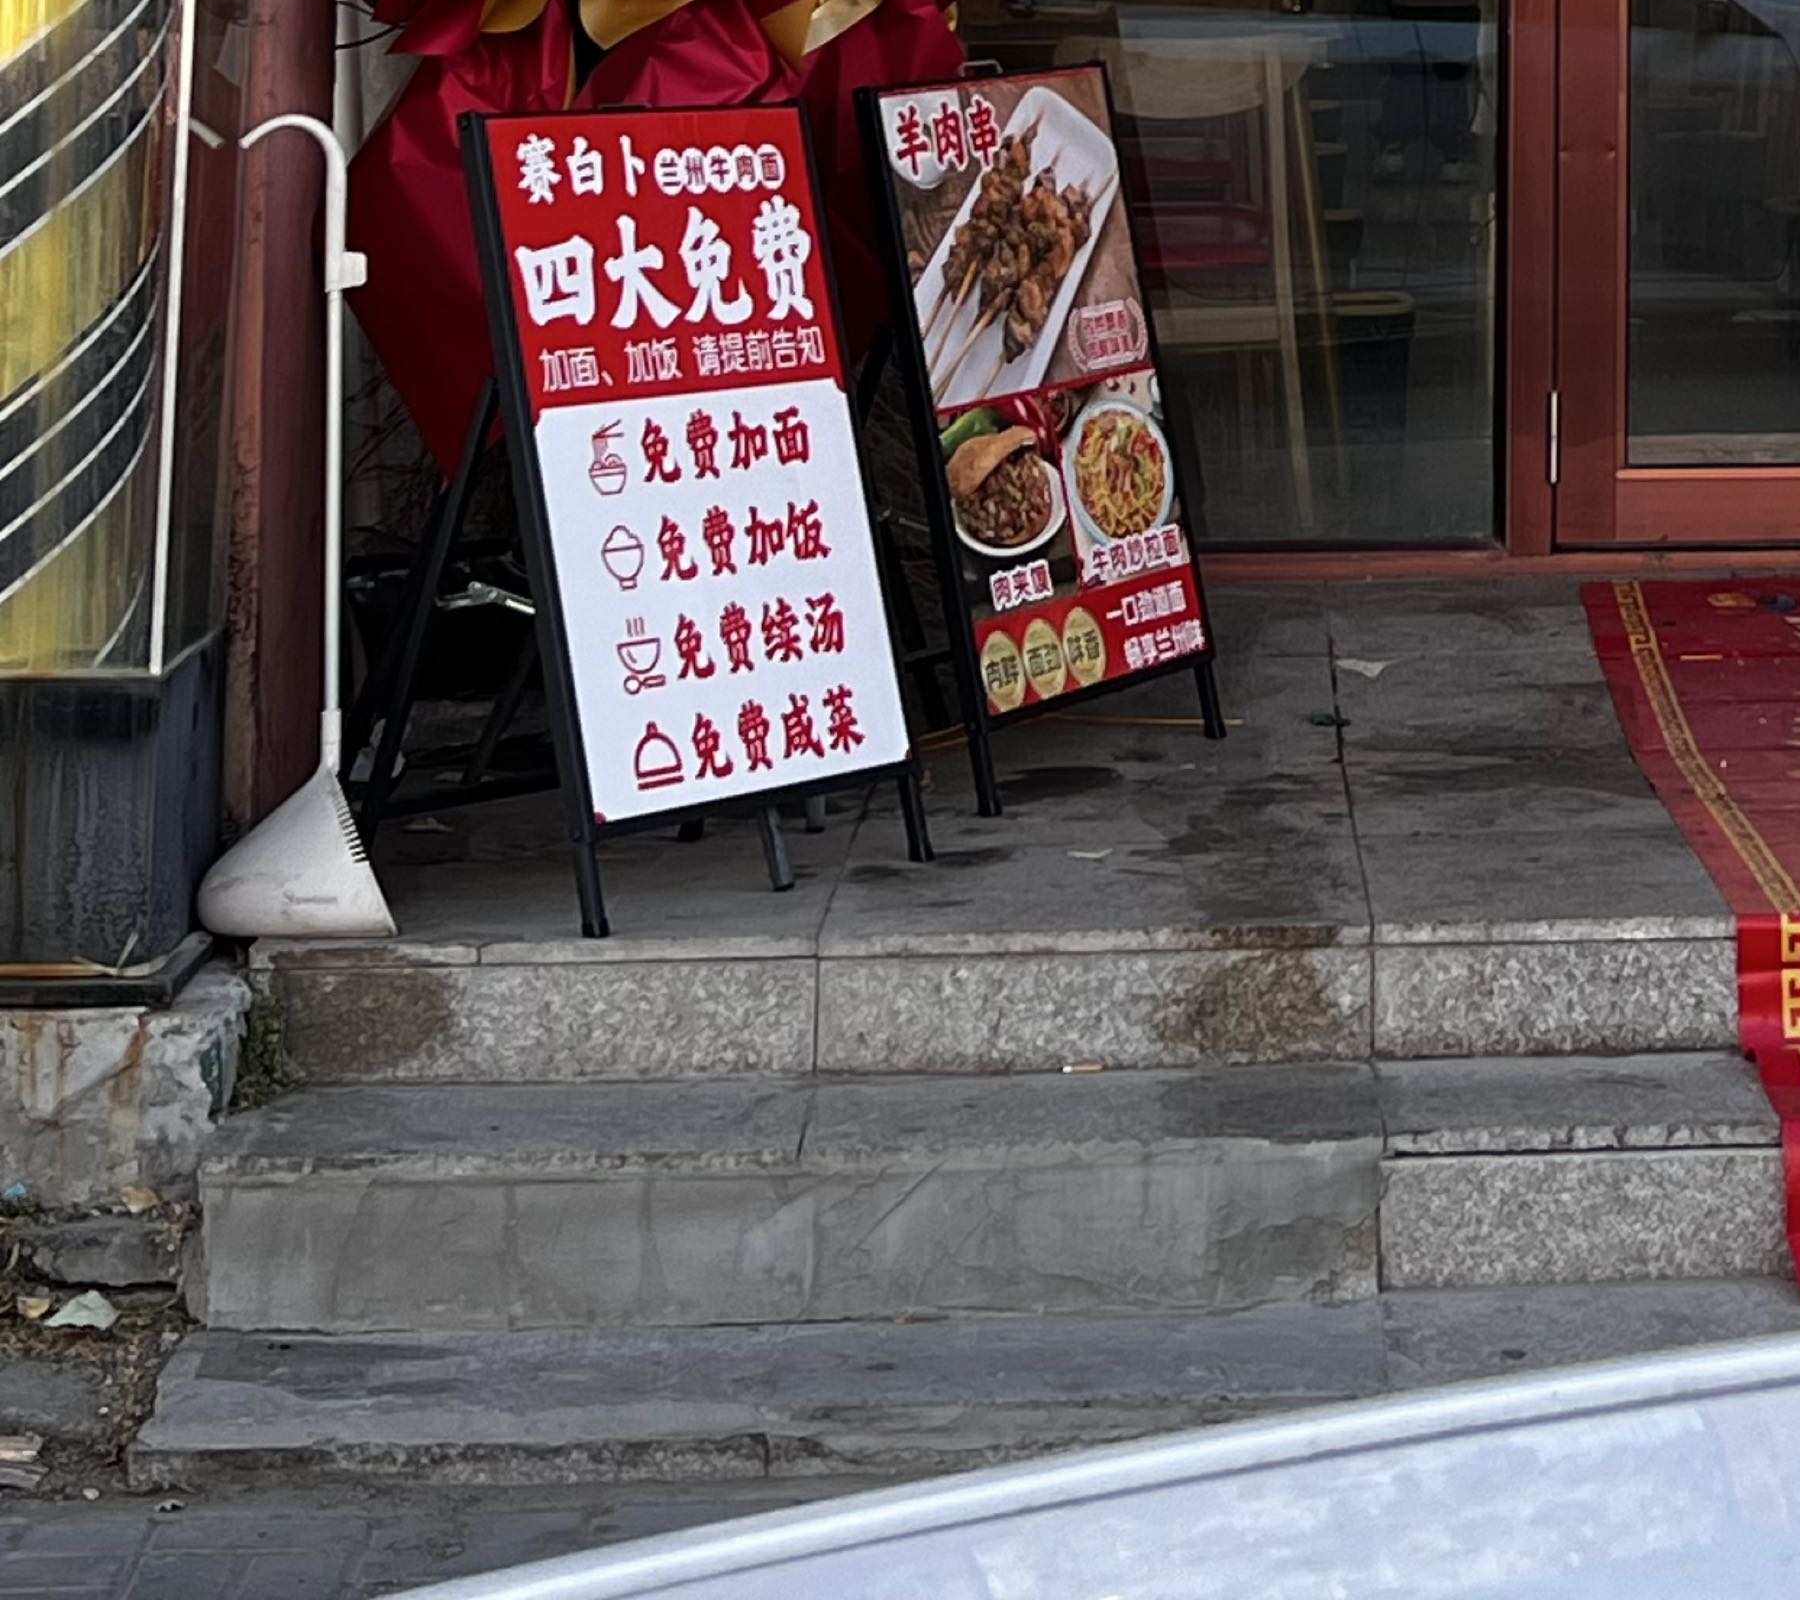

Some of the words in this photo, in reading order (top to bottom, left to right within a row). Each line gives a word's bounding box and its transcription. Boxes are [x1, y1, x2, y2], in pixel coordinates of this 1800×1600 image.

[653, 143, 786, 196] 兰州牛肉面
[895, 96, 1001, 176] 羊肉串
[515, 195, 816, 329] 四大免费
[692, 326, 825, 377] 请提前告知
[640, 406, 811, 484] 免费加面
[657, 499, 832, 582] 免费加饭
[674, 593, 847, 680] 免费续汤
[691, 684, 866, 780] 免费咸菜
